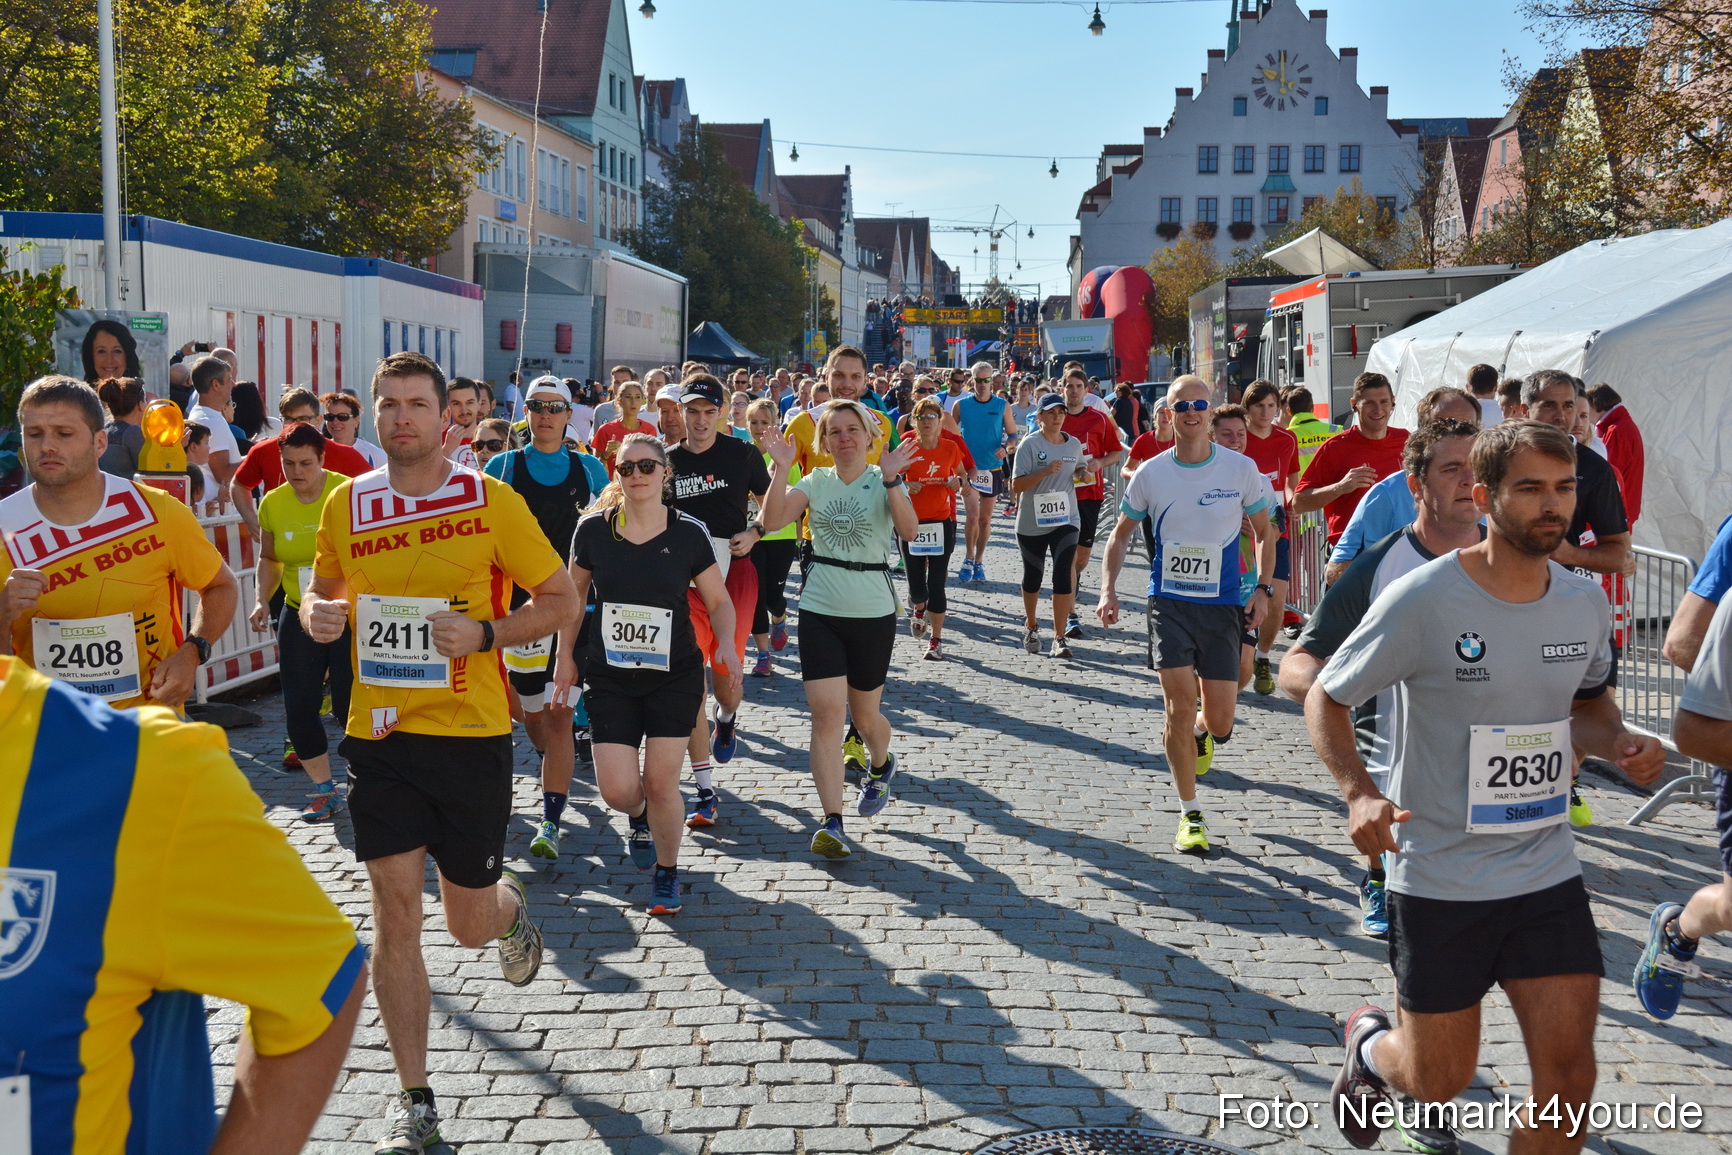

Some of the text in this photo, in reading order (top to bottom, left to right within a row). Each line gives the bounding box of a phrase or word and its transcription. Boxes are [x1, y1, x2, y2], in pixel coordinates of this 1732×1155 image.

[935, 311, 969, 320] START
[675, 476, 707, 488] SWIM.
[1040, 501, 1066, 514] 2014
[350, 517, 490, 559] MAX BÖGL
[913, 532, 937, 543] 2511
[43, 534, 166, 595] AX BÖGL
[1170, 556, 1211, 575] 2071
[1174, 582, 1206, 591] Christian
[381, 604, 420, 616] BOCK
[622, 610, 652, 620] BOCK
[61, 625, 107, 637] BOCK
[369, 621, 429, 650] 2411
[612, 622, 661, 643] 3047
[49, 640, 123, 669] 2408
[1542, 642, 1588, 659] BOCK
[375, 664, 425, 678] Christian
[1456, 667, 1490, 676] PARTL
[1456, 675, 1491, 683] Neumarkt
[1505, 732, 1552, 747] BOCK
[1487, 750, 1562, 787] 2630
[1519, 789, 1548, 798] Neumarkt
[1505, 805, 1544, 821] Stefan
